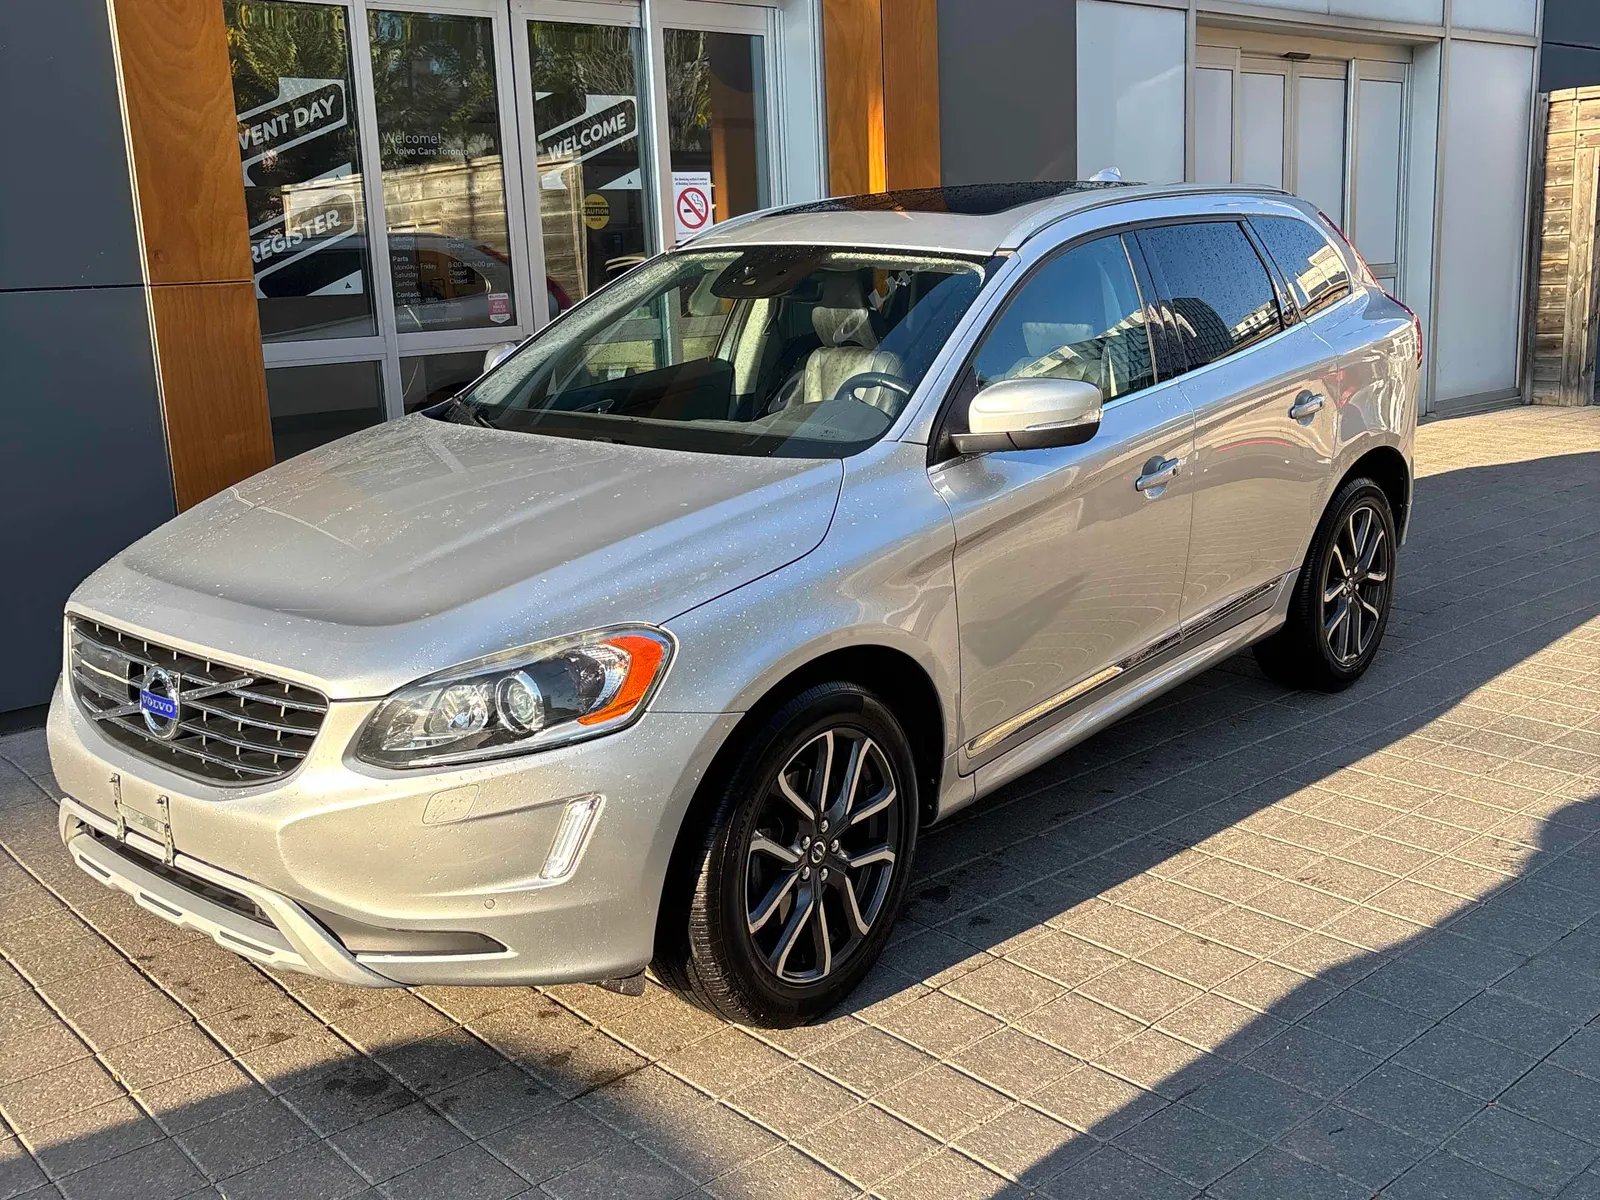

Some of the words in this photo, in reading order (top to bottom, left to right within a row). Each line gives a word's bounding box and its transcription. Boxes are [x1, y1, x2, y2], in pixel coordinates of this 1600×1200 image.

[238, 113, 290, 150] VENT
[293, 94, 335, 129] DAY
[381, 131, 441, 144] Welcome!
[548, 112, 627, 162] WELCOME
[393, 147, 416, 155] Volvo
[418, 147, 437, 155] Cars
[438, 147, 469, 156] Toronto
[251, 209, 342, 263] REGISTER
[420, 262, 437, 270] Friday
[394, 271, 419, 279] Saturday
[142, 694, 174, 714] VOLVO
